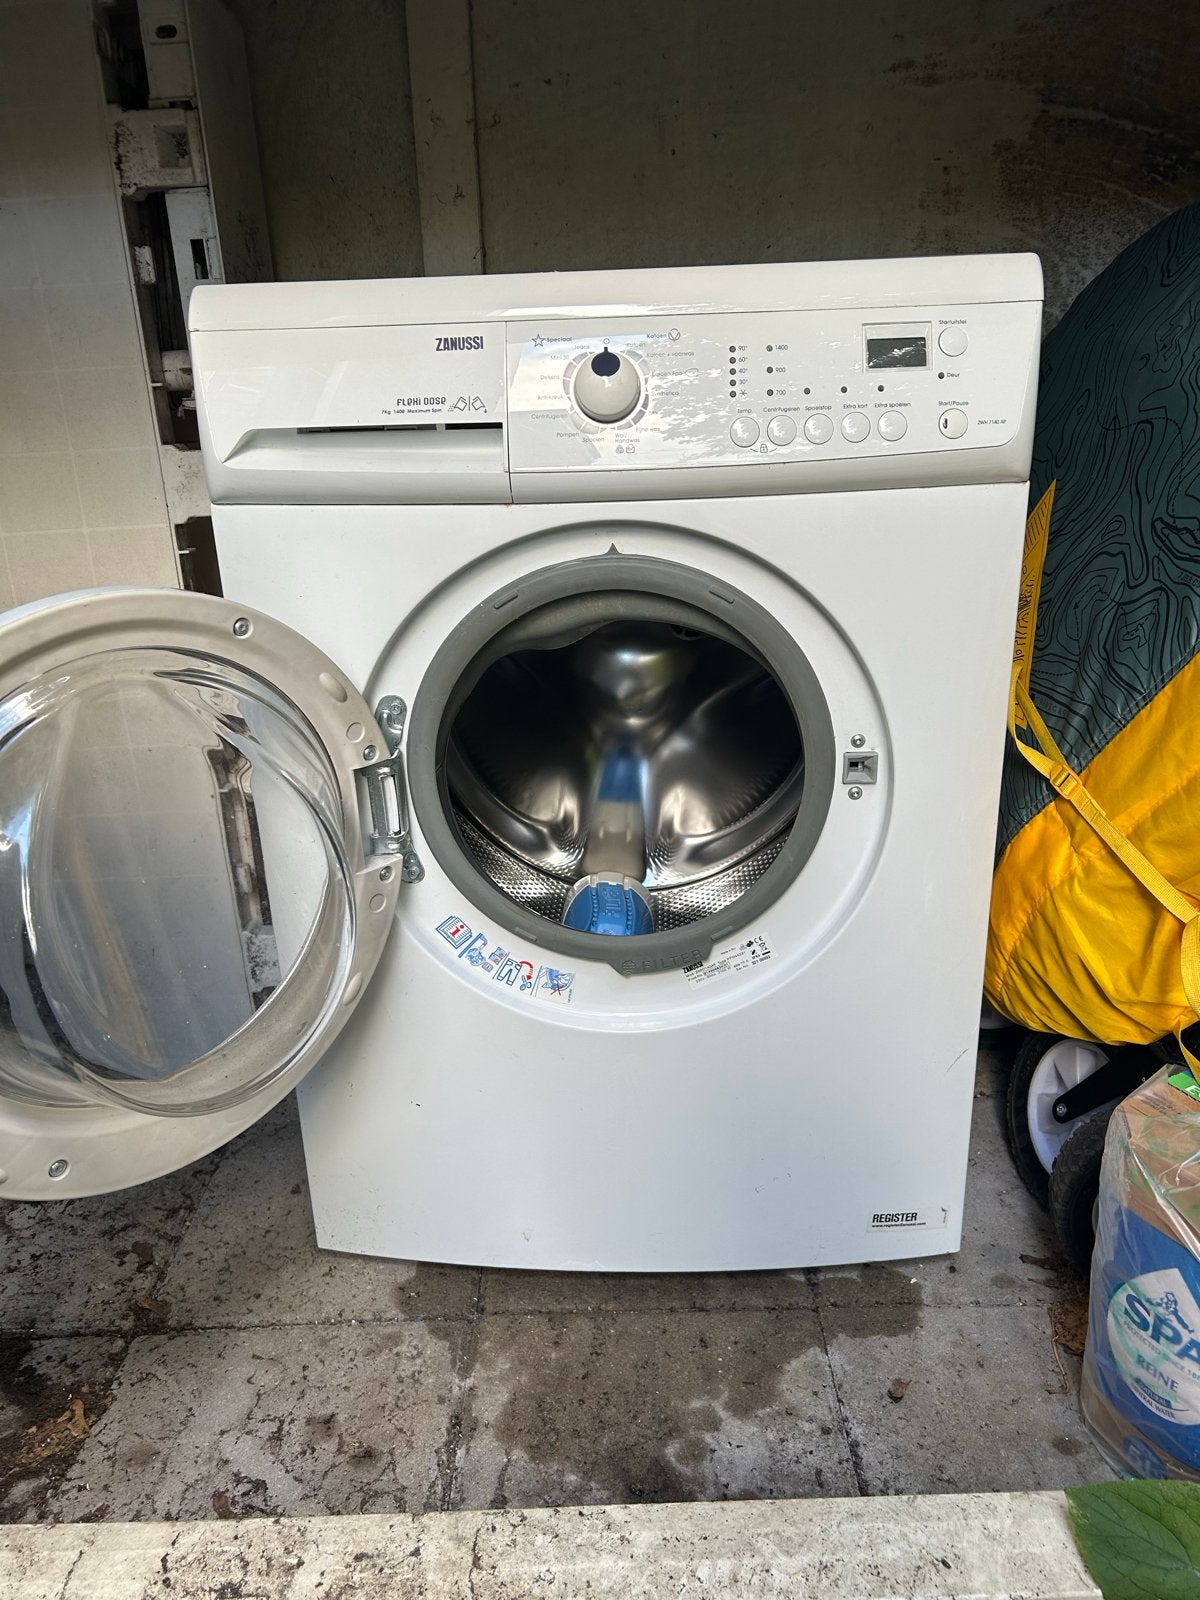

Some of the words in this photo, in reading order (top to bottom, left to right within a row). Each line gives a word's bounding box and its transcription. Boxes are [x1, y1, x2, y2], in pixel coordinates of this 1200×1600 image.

[435, 336, 484, 351] ZANUSSI
[546, 336, 573, 344] Speciaal
[642, 949, 704, 970] FILTER
[872, 1212, 918, 1223] REGISTER
[1123, 1293, 1200, 1366] SPA
[1136, 1353, 1180, 1394] REINE
